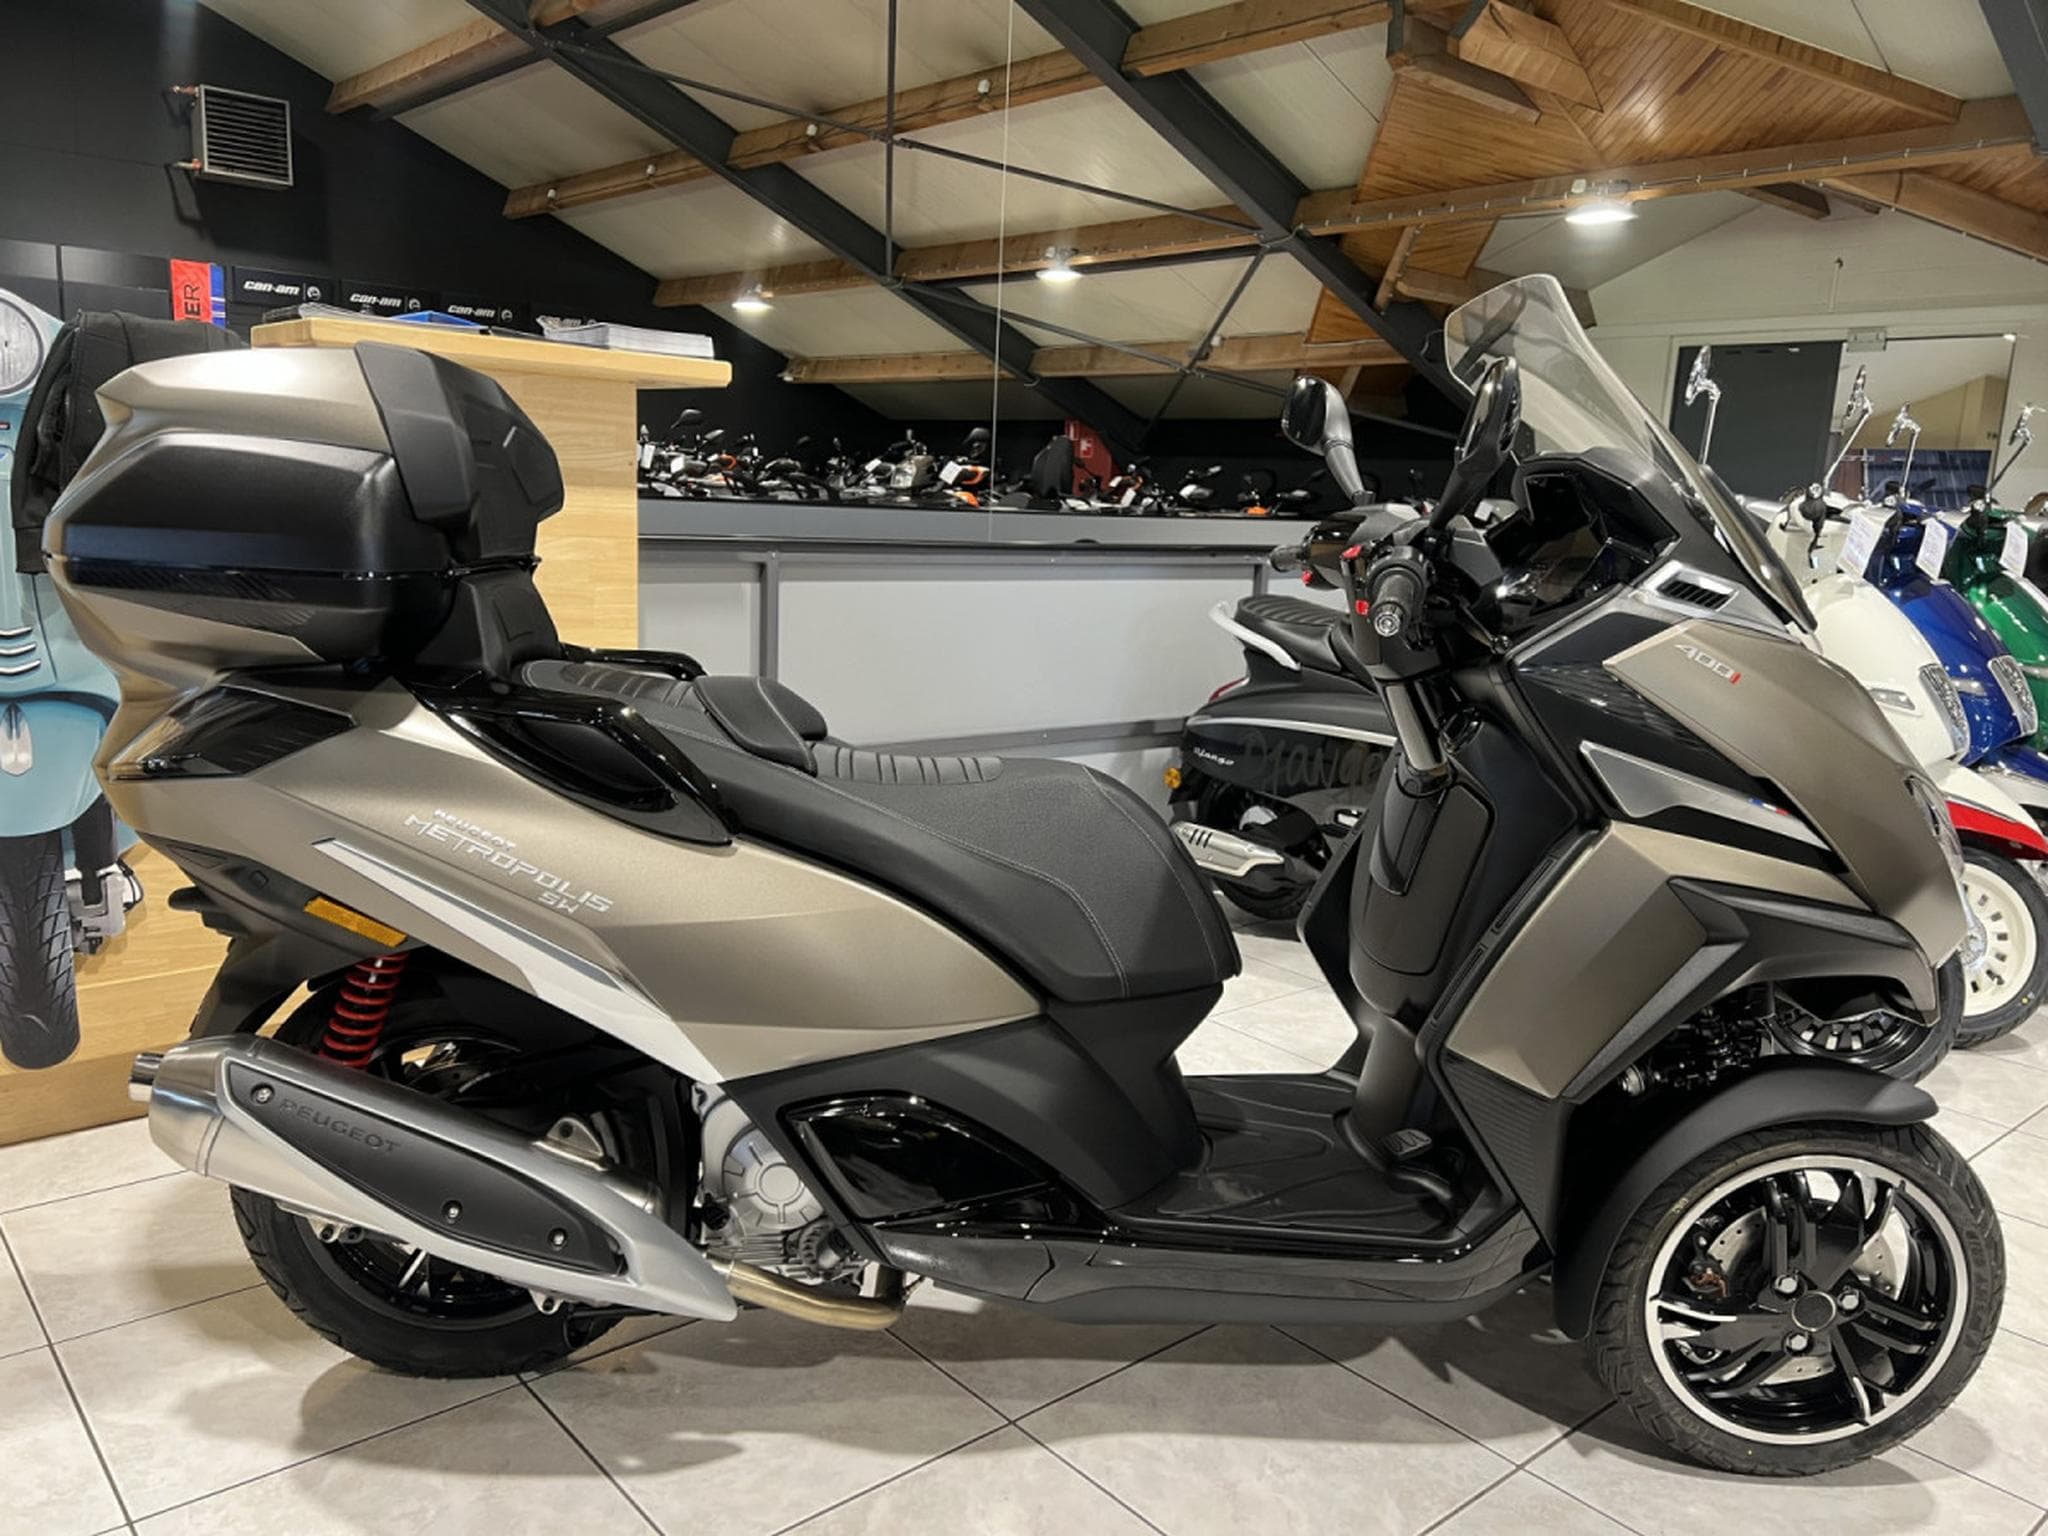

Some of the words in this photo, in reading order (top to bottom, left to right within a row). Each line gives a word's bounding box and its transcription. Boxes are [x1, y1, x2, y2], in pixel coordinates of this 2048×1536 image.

[183, 284, 201, 320] ER
[243, 280, 300, 296] can-am
[349, 292, 402, 308] can-am
[447, 304, 496, 318] can-am
[433, 807, 518, 851] PEUGEOT
[403, 813, 614, 913] METROPOLIS
[538, 890, 581, 915] SW
[278, 1099, 402, 1152] PEUGEOT
